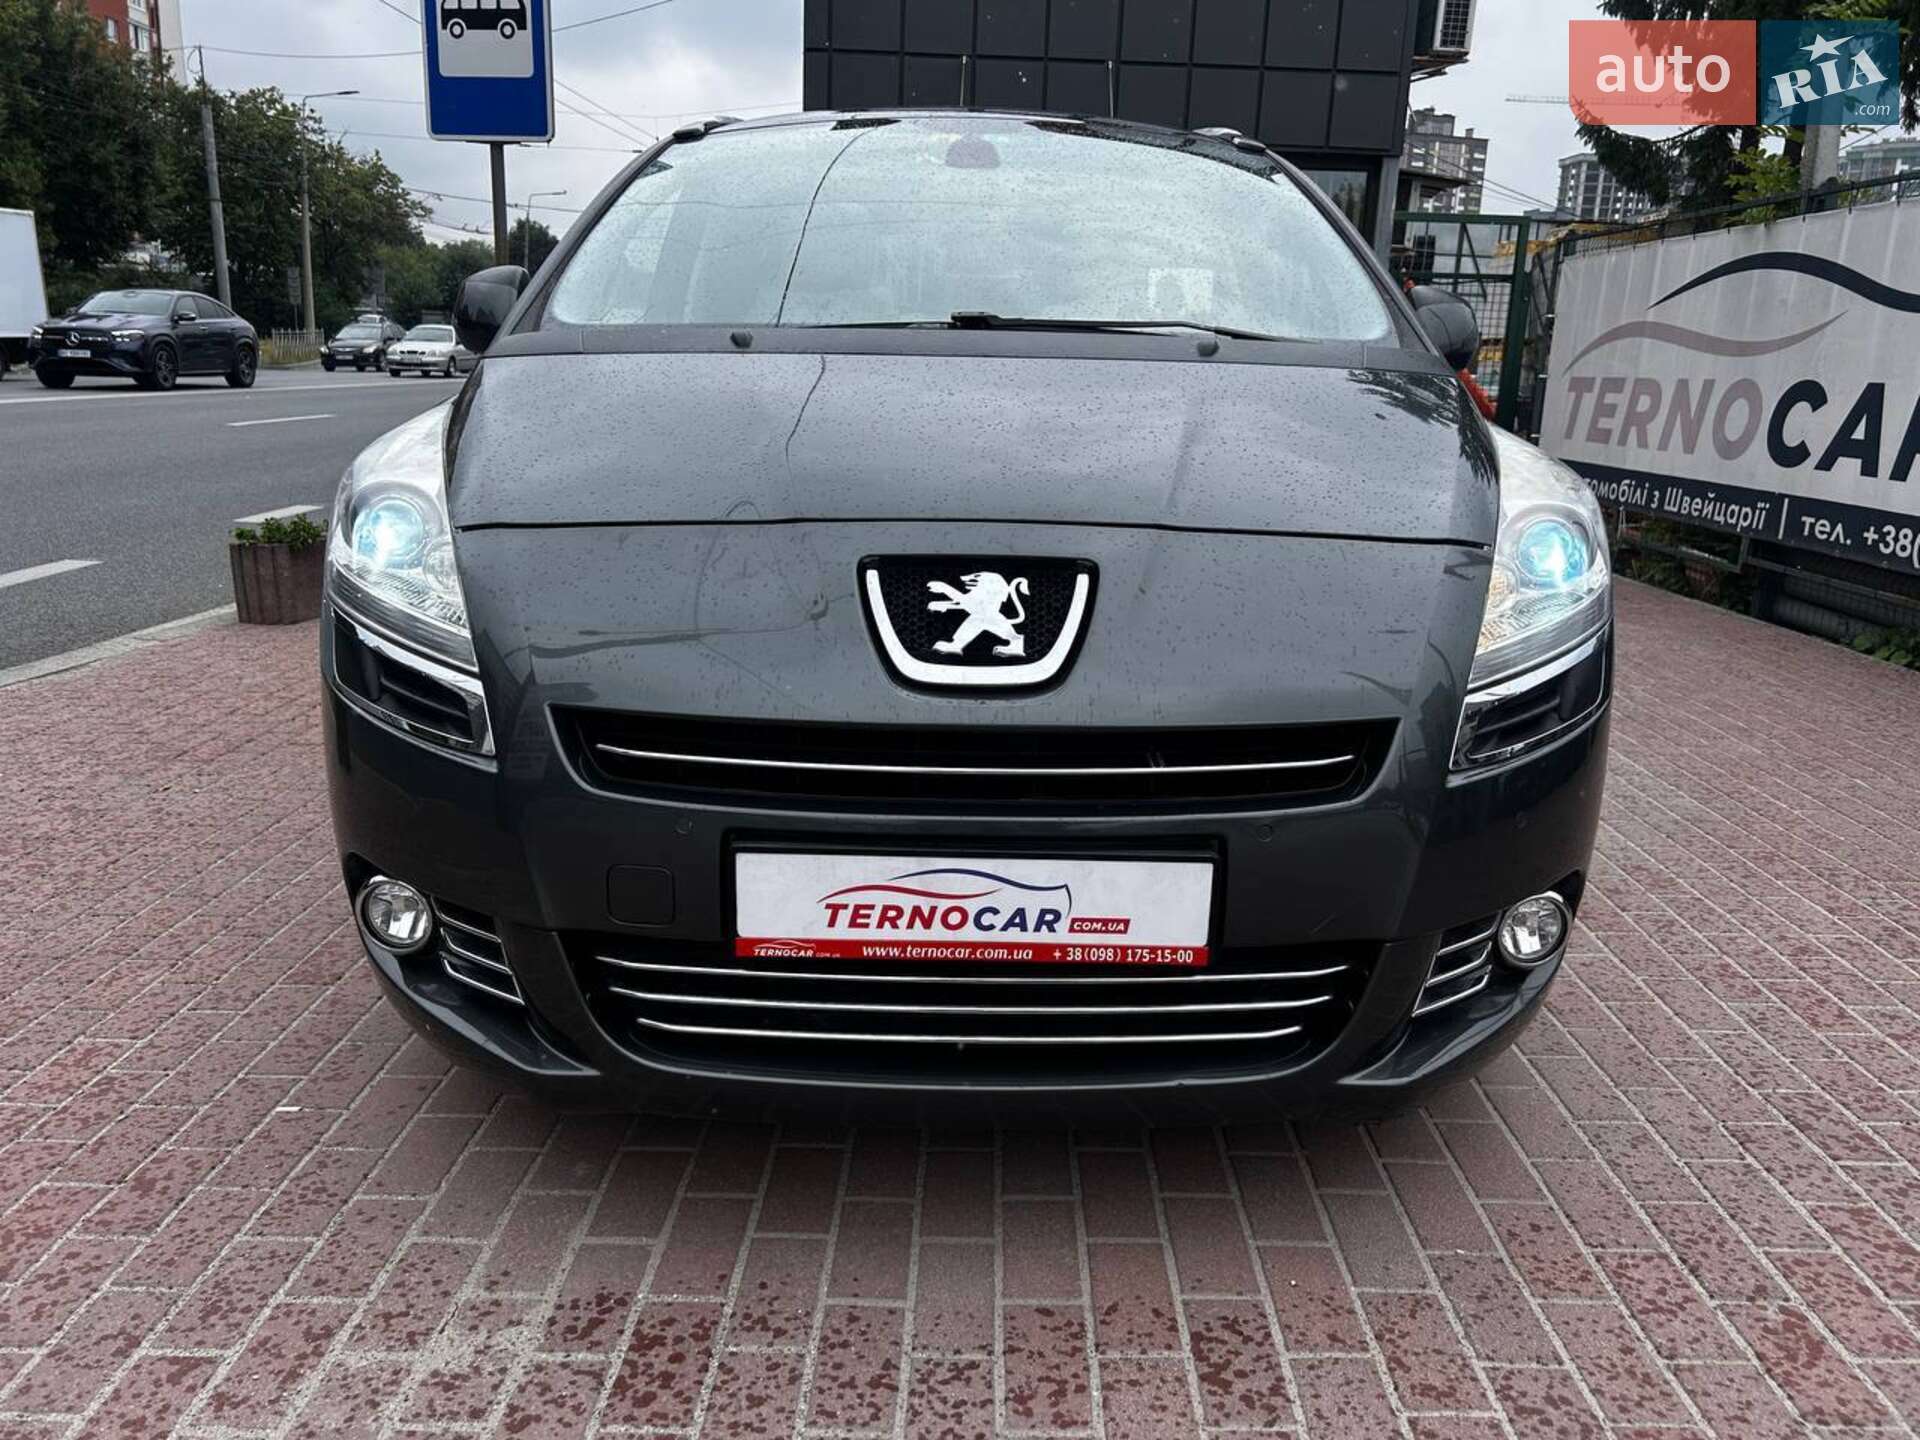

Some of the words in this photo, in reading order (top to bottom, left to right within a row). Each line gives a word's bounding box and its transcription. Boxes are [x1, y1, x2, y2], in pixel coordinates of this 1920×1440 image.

[1650, 490, 1660, 509] з
[1663, 486, 1770, 531] Швейцарії
[1801, 515, 1852, 545] тел.
[824, 903, 1062, 934] TERNOCAR
[1073, 920, 1126, 932] COM.UA
[754, 949, 814, 958] TERNOCAR
[862, 945, 1032, 961] www.ternocar.com.ua
[1126, 949, 1194, 963] 175-15-00
